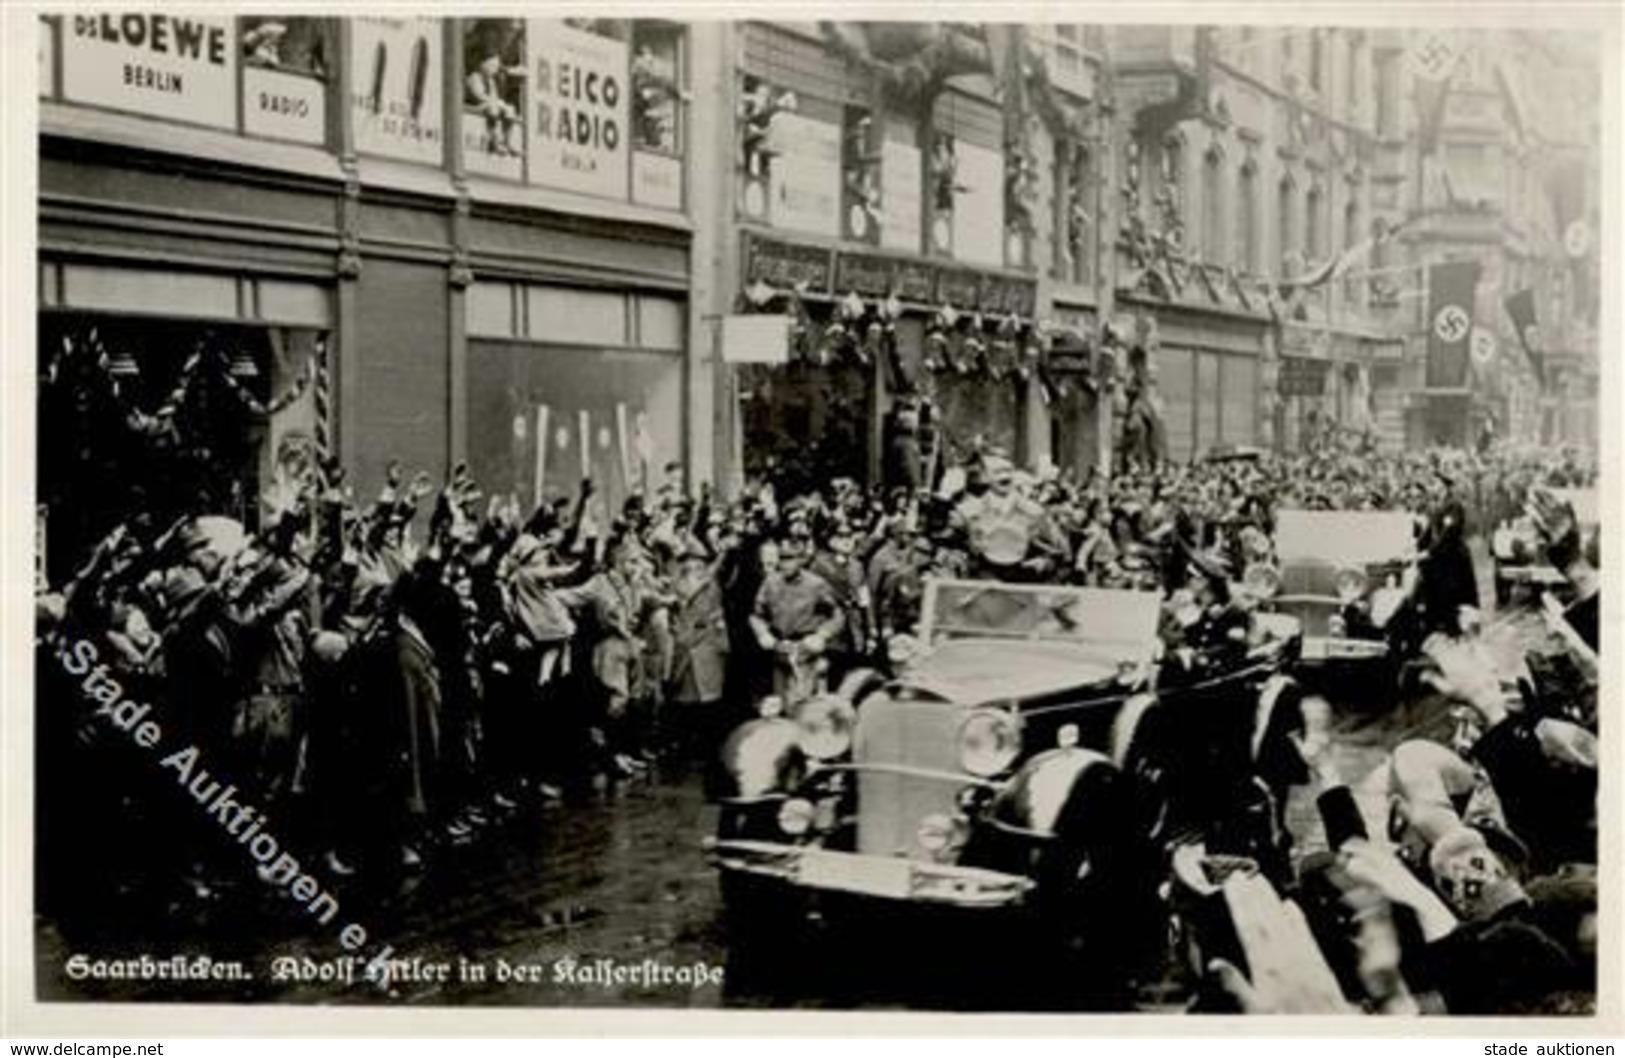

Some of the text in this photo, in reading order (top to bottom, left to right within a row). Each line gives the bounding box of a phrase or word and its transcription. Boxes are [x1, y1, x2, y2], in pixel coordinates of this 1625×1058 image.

[101, 14, 225, 65] LOEWE
[123, 64, 182, 93] BERLIN
[537, 56, 619, 108] REICO
[260, 92, 309, 118] RADIO
[537, 101, 619, 151] RADIO
